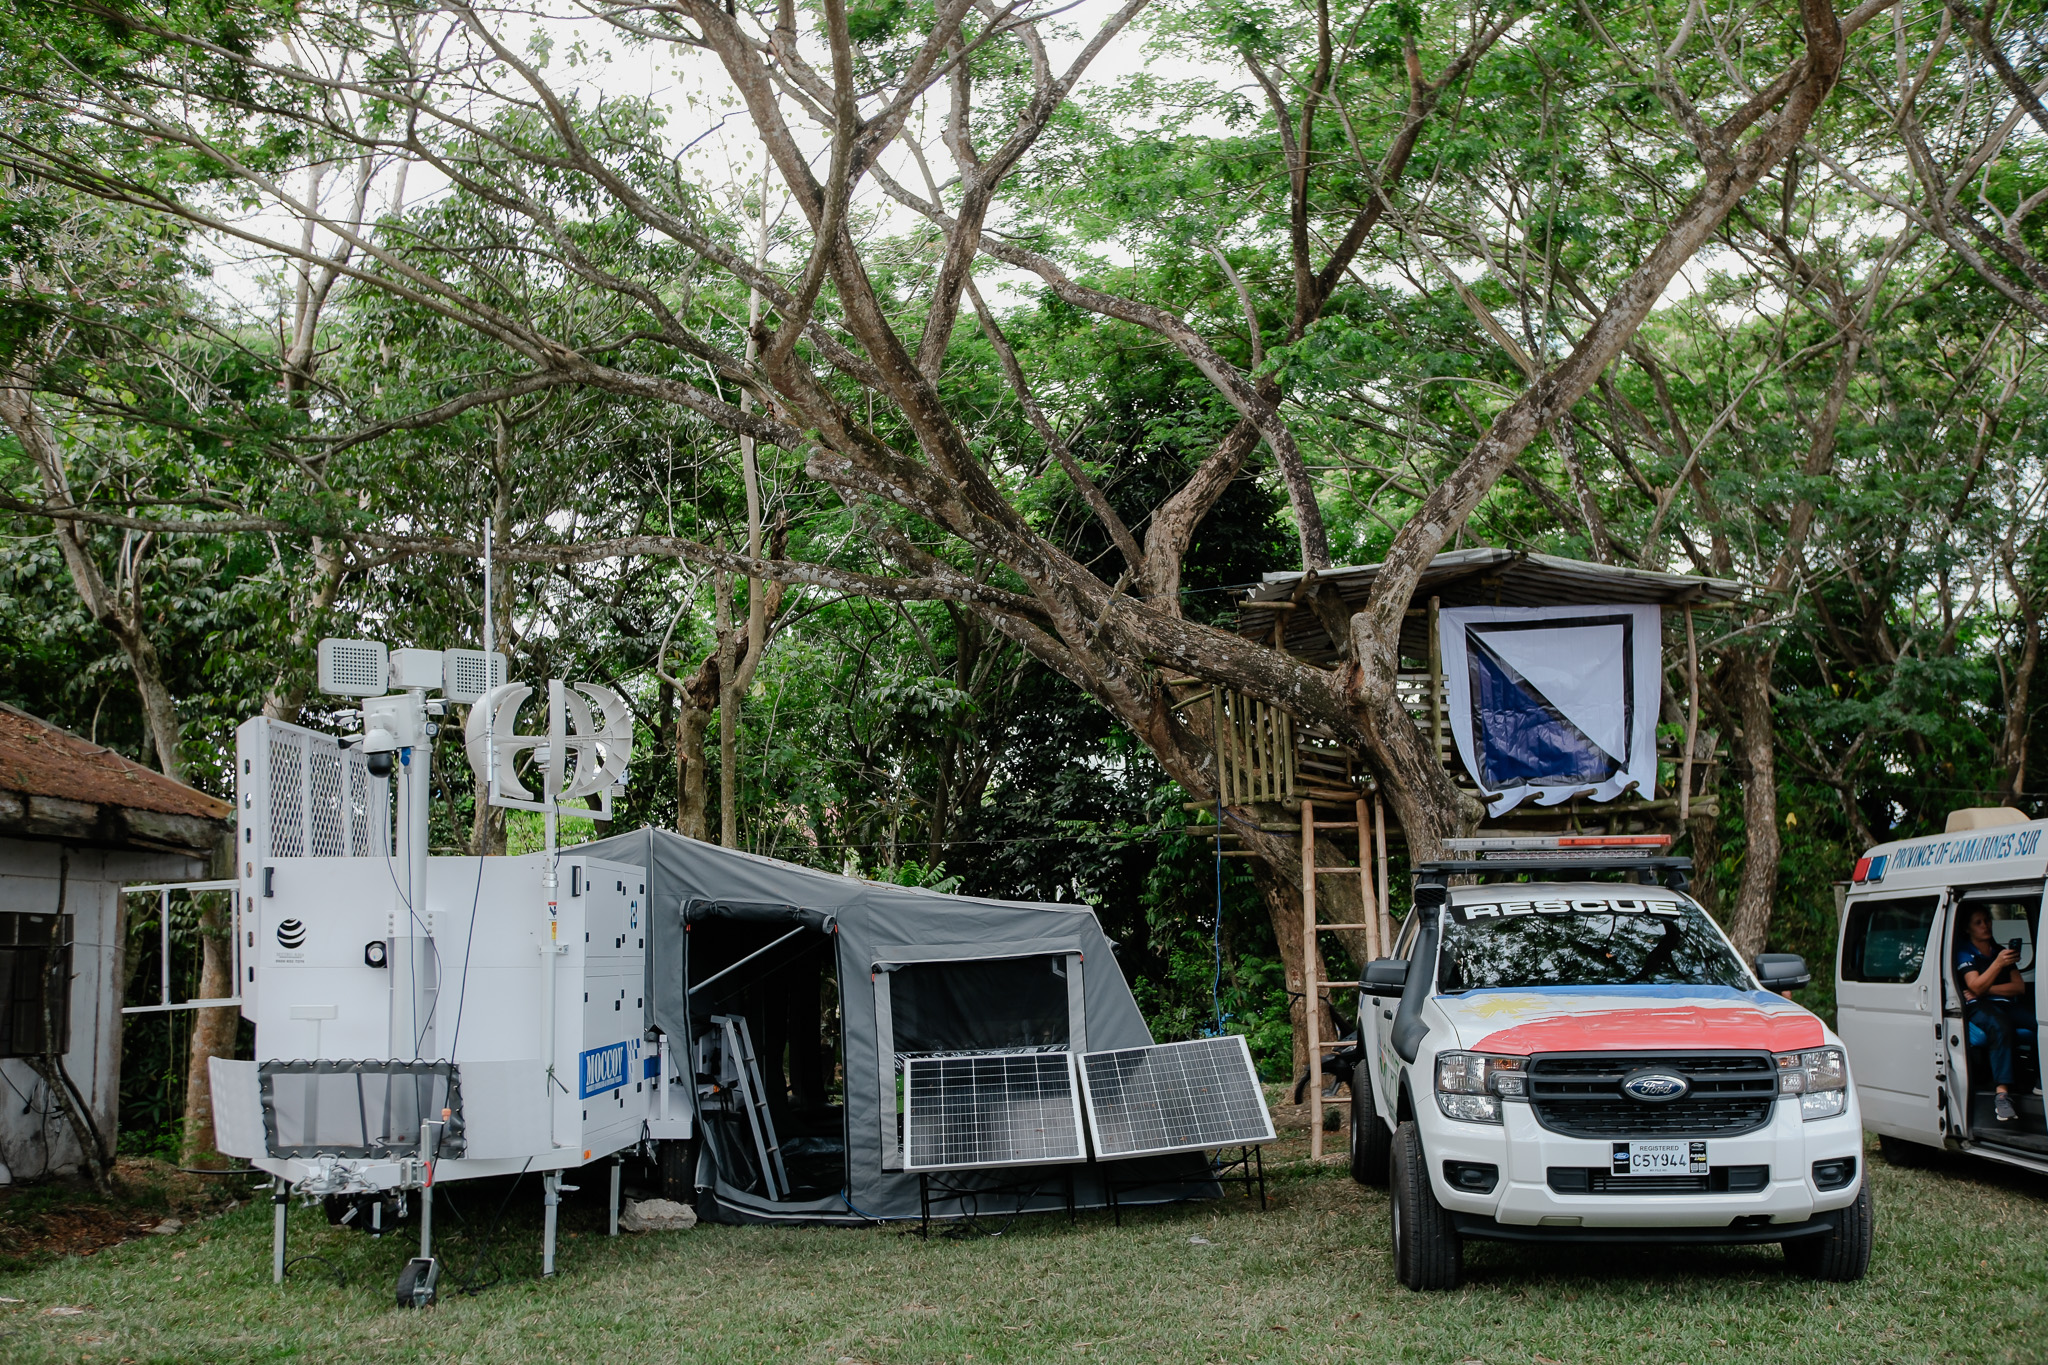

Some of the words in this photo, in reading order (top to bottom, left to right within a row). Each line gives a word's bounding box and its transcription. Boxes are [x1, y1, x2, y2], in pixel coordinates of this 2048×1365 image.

[1892, 843, 1937, 870] PROVINCE
[1934, 841, 1952, 865] OF
[1949, 832, 2016, 864] CAMARINES
[2014, 829, 2042, 857] SUR
[1464, 899, 1681, 921] RESCUE
[1641, 1080, 1673, 1095] Ford
[1632, 1153, 1687, 1167] C5Y944
